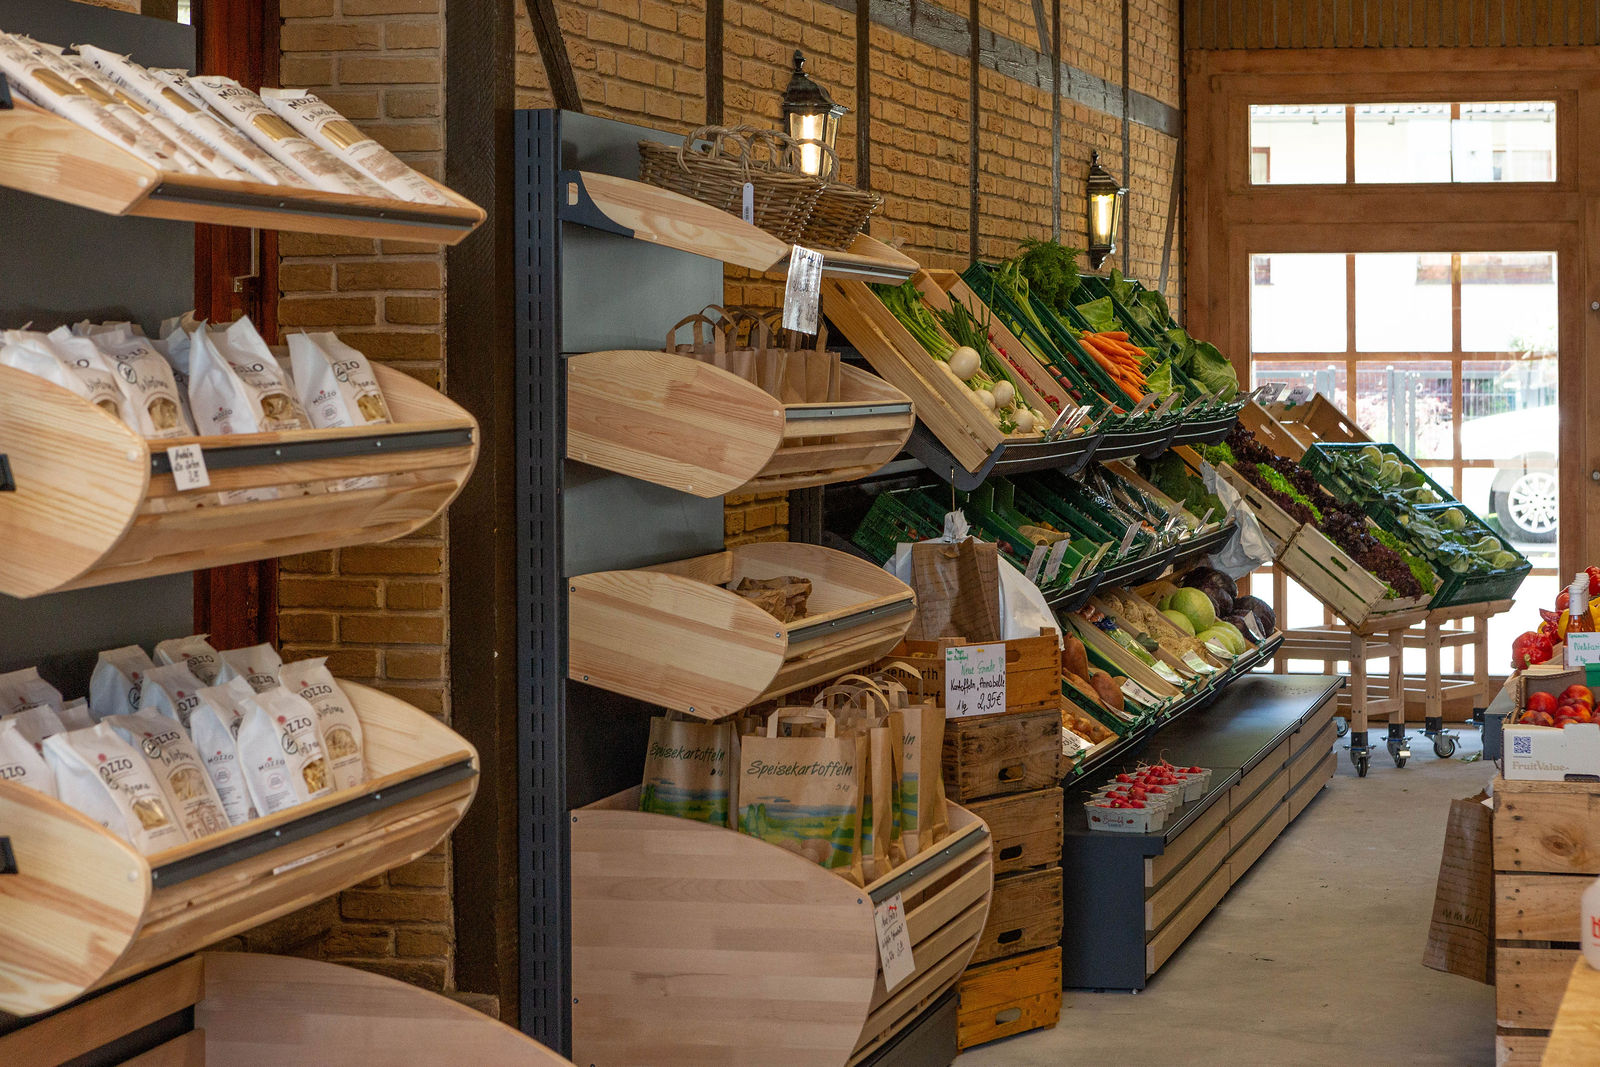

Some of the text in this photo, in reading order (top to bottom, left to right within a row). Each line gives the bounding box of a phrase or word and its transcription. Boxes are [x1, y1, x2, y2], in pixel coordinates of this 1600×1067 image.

[218, 87, 252, 100] MOZZ
[288, 97, 319, 110] MOZZ
[99, 758, 133, 777] OZZO
[746, 760, 853, 778] Speisekartoffeln
[1512, 760, 1564, 772] FruitValue
